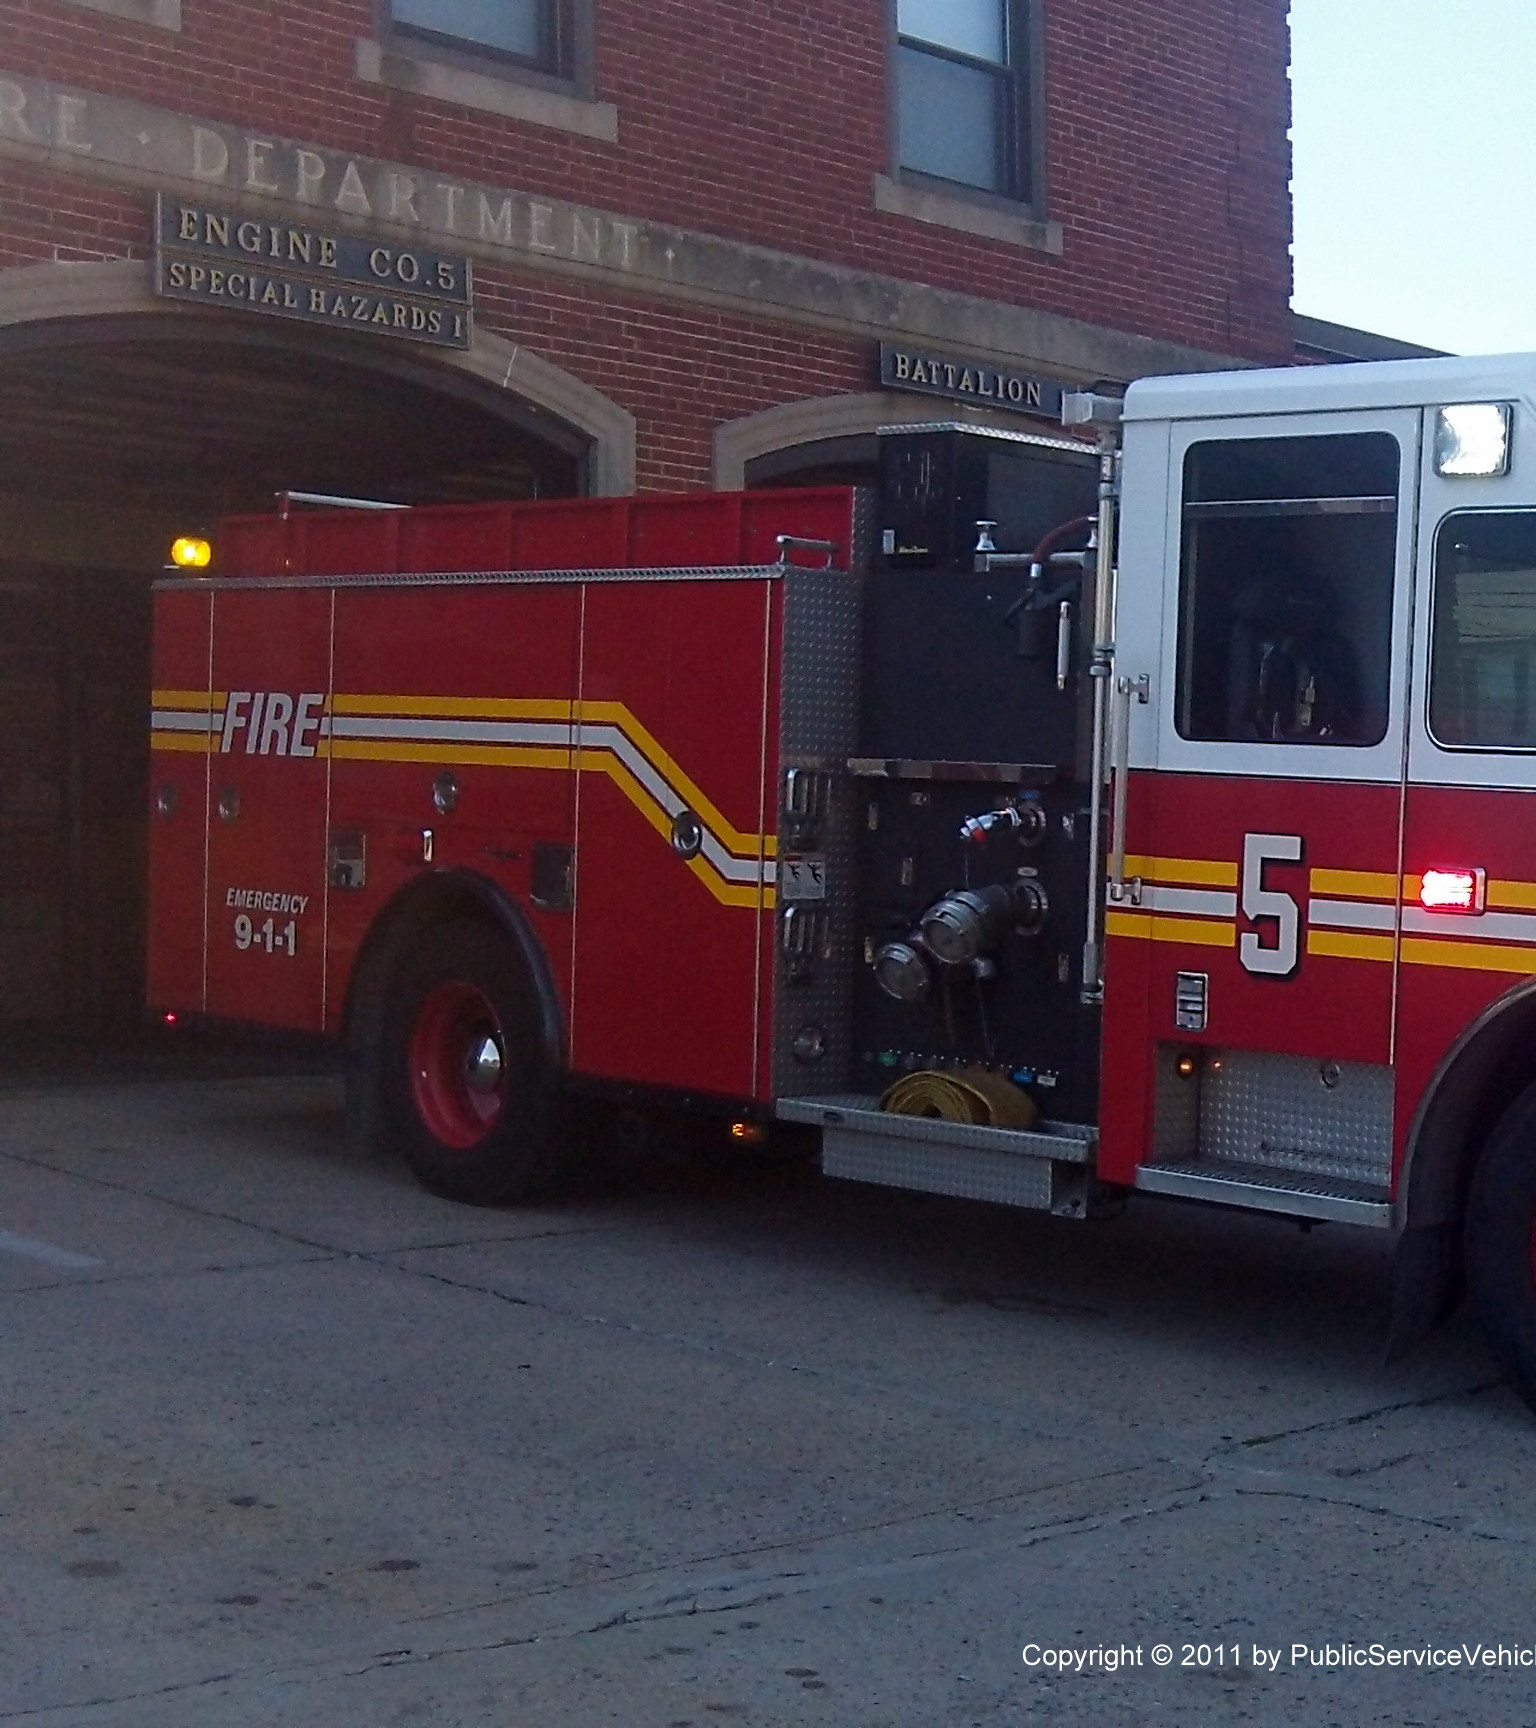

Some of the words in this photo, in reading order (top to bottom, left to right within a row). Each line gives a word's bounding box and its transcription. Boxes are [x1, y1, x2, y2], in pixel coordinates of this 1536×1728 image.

[192, 124, 638, 268] DEPARTMENT
[178, 208, 337, 269] ENGINE
[169, 262, 298, 309] SPECIAL
[309, 288, 441, 334] HAZARDS
[895, 352, 1041, 406] BATTALION
[221, 691, 323, 757] FIRE
[226, 887, 308, 914] EMERGENCY
[1239, 832, 1301, 975] 5
[234, 913, 297, 956] 9-1-1
